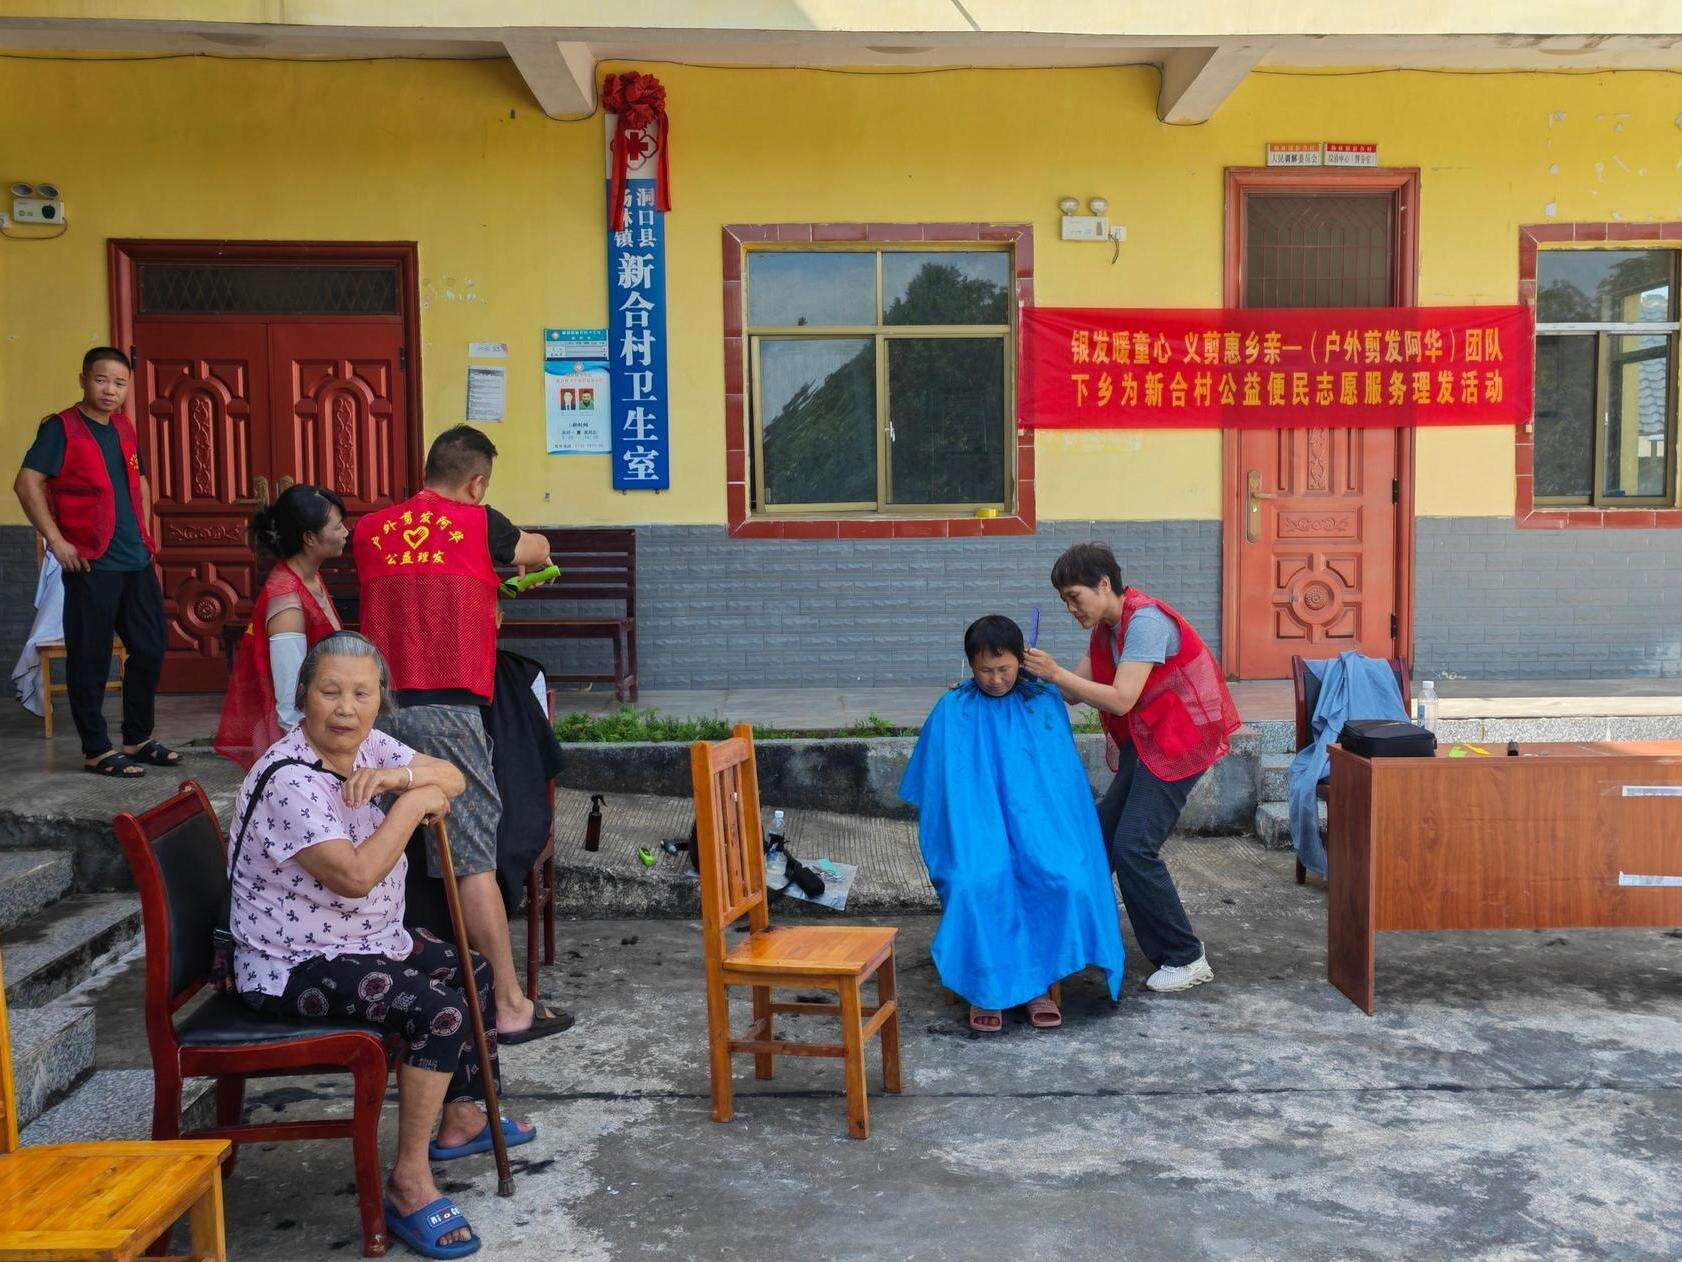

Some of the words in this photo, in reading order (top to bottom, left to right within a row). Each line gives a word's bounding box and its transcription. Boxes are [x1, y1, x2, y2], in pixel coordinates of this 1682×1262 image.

[636, 188, 656, 247] 洞口县
[618, 252, 659, 481] 新合村卫生室
[1071, 329, 1172, 365] 银发暖童心
[1071, 370, 1503, 407] 下乡为新合村公益便民志愿服务理发活动
